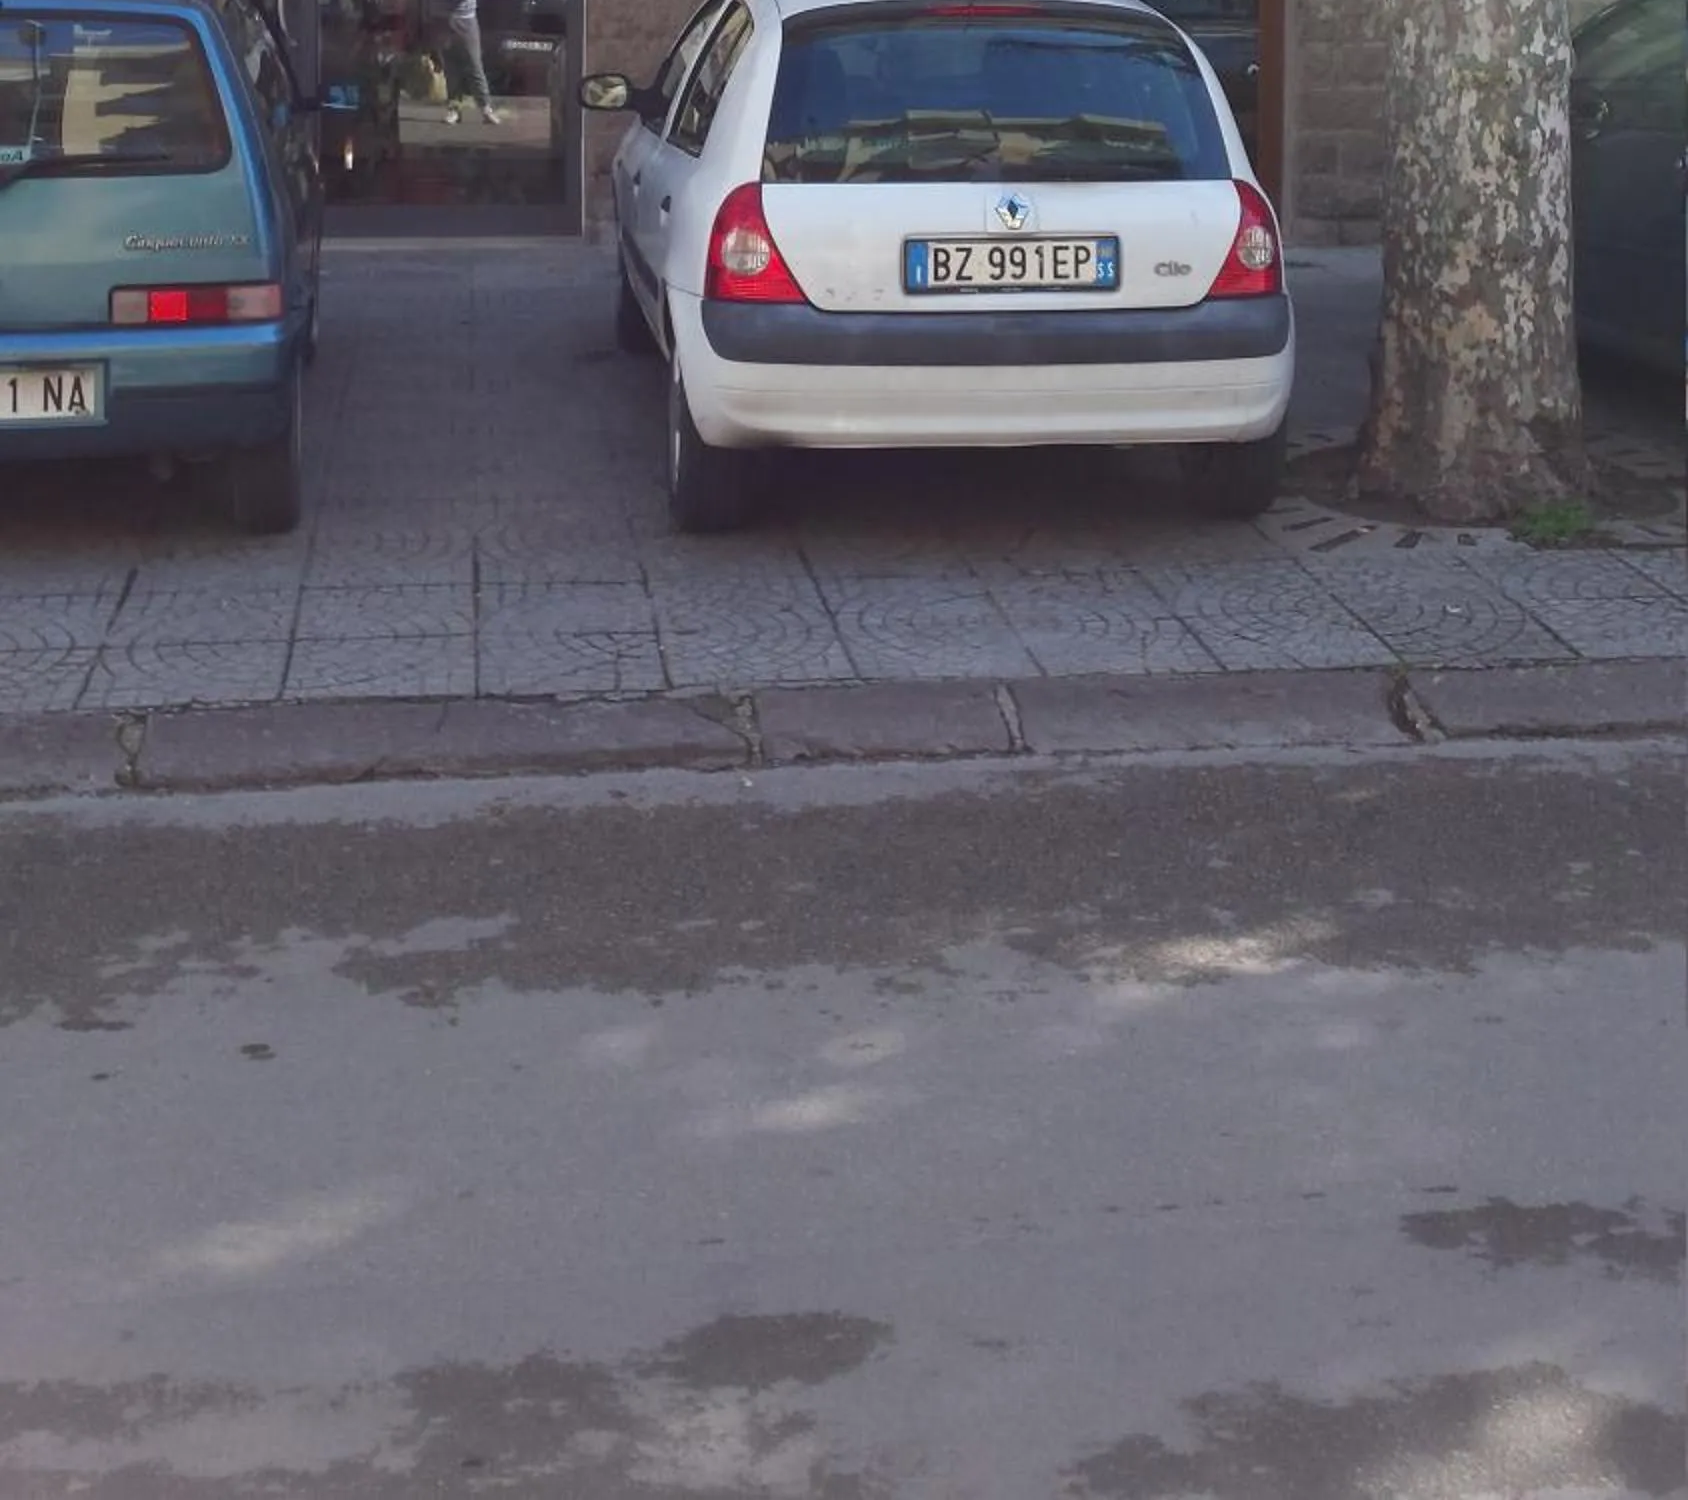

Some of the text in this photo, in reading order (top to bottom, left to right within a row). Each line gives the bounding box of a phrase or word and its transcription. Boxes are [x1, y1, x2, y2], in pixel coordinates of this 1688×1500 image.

[932, 247, 973, 282] BZ
[1153, 260, 1192, 277] Clio
[42, 375, 87, 413] NA
